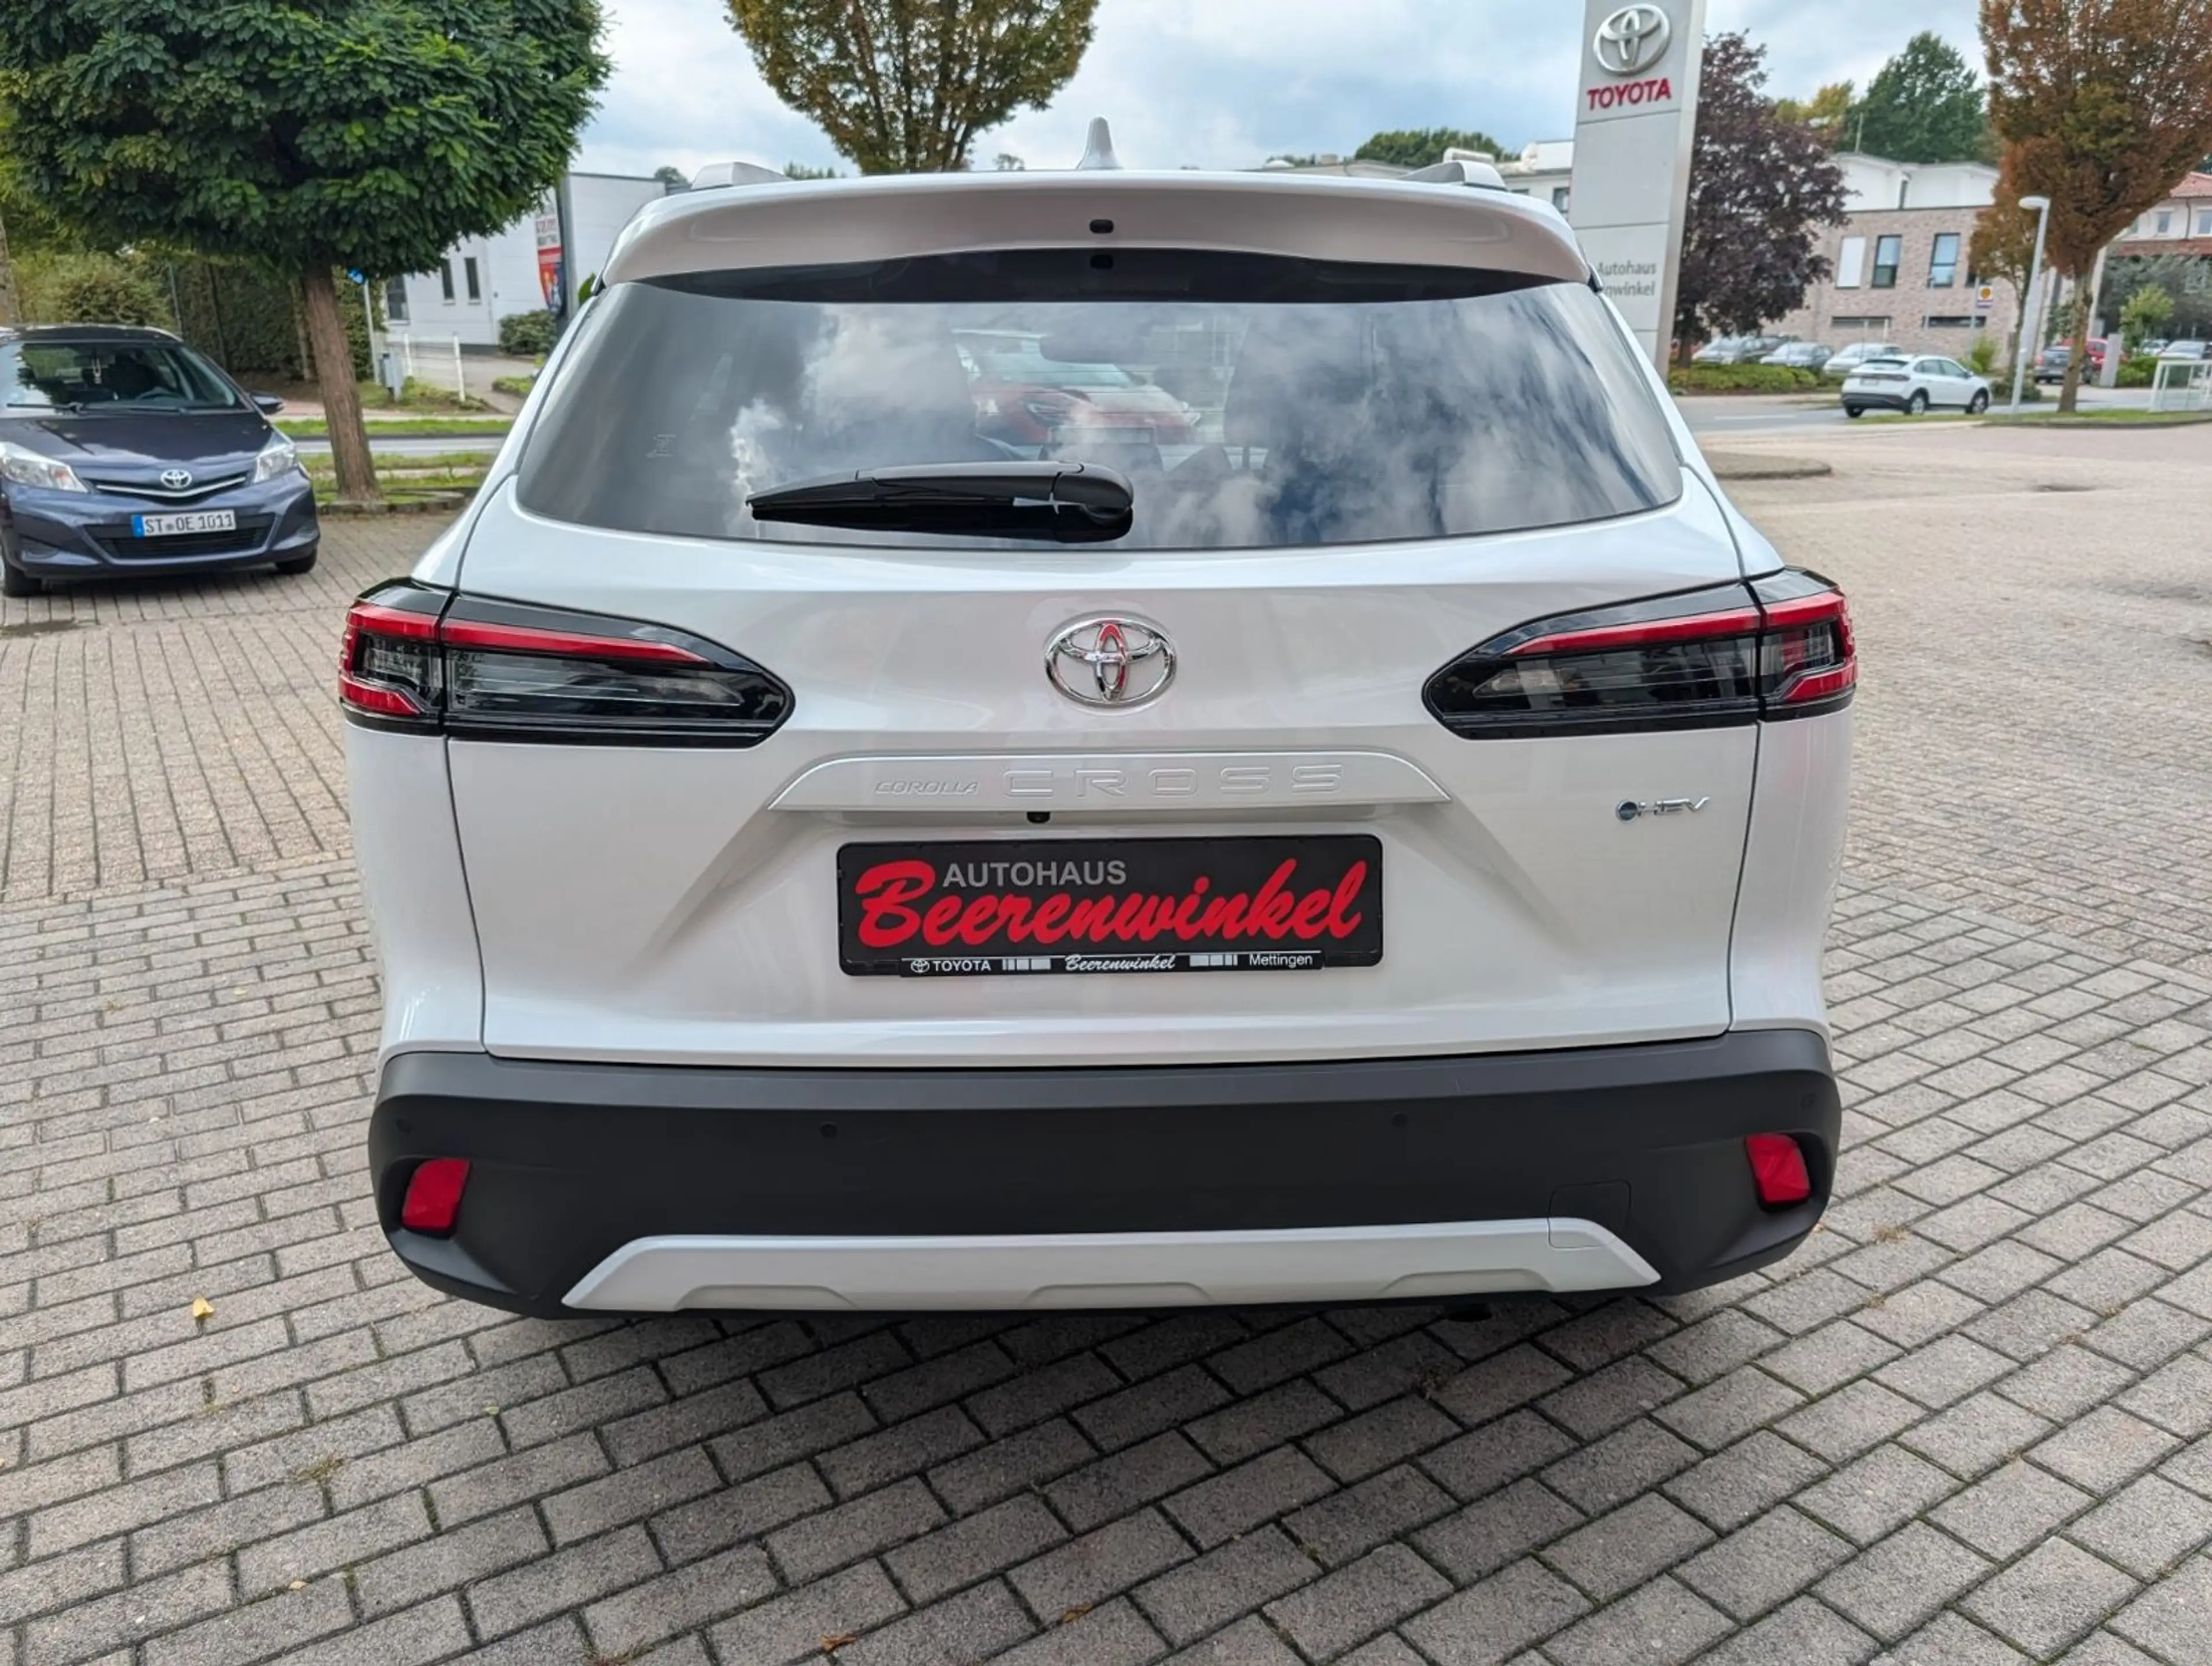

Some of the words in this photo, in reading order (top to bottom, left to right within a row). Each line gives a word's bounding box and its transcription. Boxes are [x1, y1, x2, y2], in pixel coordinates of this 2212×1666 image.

[1587, 78, 1672, 110] TOYOTA
[1597, 259, 1657, 275] Autohaus
[1603, 280, 1656, 296] nwinkel
[145, 518, 163, 533] ST
[175, 516, 195, 531] OE
[197, 513, 233, 529] 1011
[875, 780, 979, 795] COROLLA
[1002, 764, 1344, 798] CROSS
[943, 861, 1127, 888] AUTOHAUS
[855, 858, 1367, 948] Beerenwinkel
[932, 959, 992, 972] TOYOTA
[1064, 954, 1176, 972] Beerenwinkel
[1249, 953, 1313, 967] Mettingen
